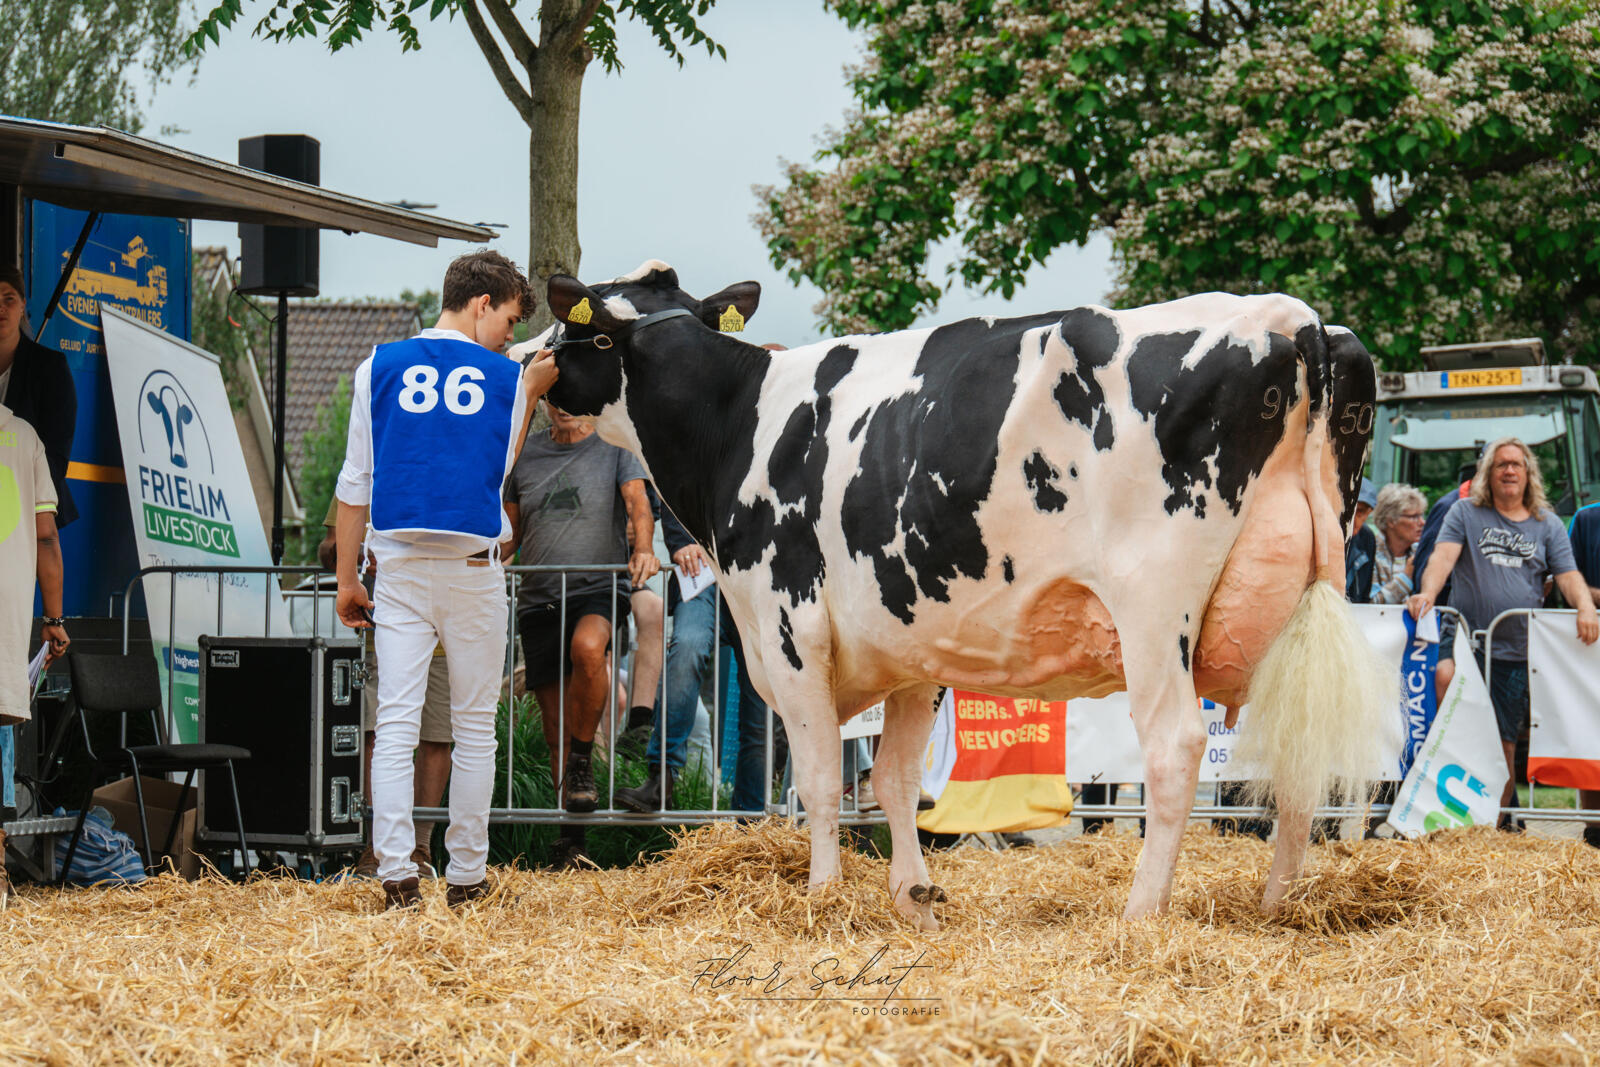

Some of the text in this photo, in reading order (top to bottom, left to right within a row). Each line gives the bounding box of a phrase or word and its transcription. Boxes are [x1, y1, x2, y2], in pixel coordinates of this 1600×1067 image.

[398, 365, 486, 415] 86
[1454, 371, 1515, 385] TRN-25-T
[139, 465, 231, 521] FRIELIM
[146, 510, 235, 552] LIVESTOCK
